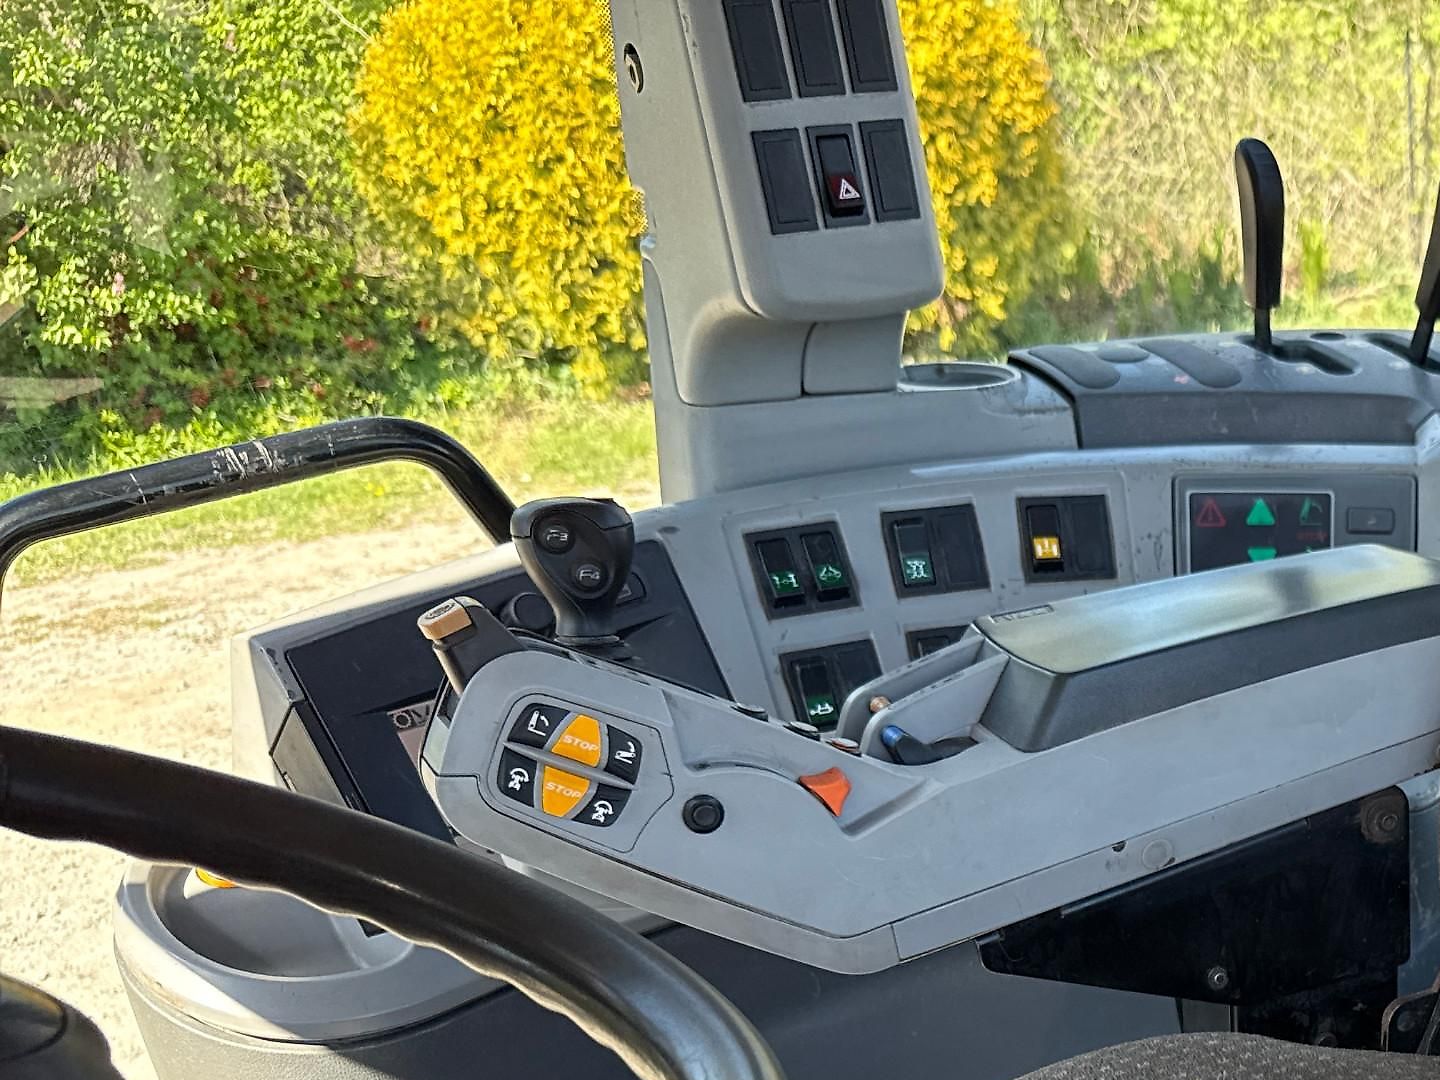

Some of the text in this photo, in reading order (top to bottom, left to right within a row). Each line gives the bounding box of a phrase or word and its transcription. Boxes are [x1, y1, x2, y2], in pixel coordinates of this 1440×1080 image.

[580, 569, 600, 580] F4
[562, 735, 599, 752] STOP
[545, 781, 584, 799] STOP
